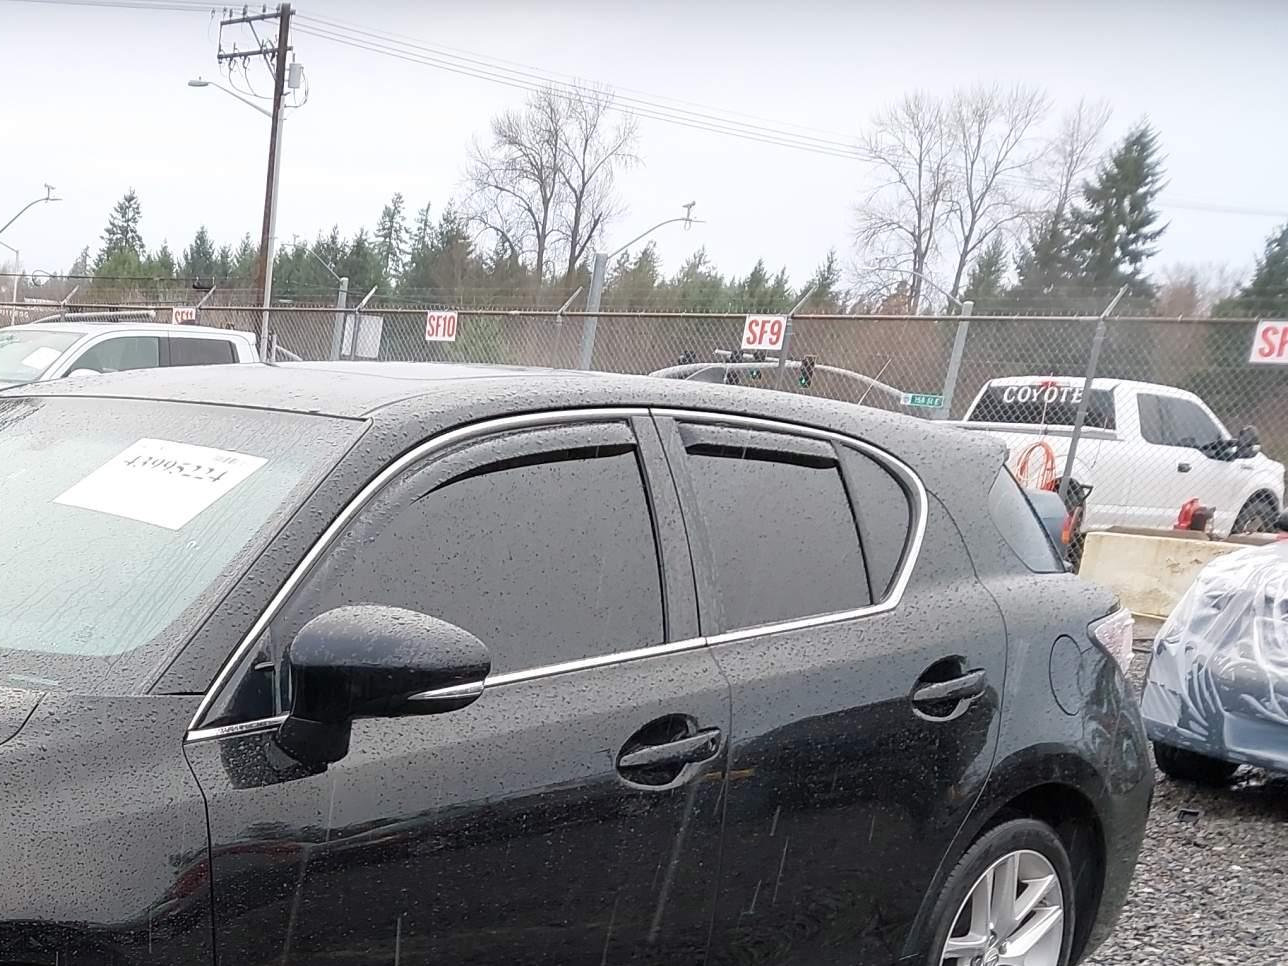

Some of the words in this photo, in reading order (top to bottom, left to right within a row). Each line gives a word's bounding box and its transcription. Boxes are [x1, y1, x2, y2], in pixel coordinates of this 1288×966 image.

[427, 314, 456, 337] SF10
[746, 319, 783, 346] SF9
[1003, 386, 1084, 404] COYOTE
